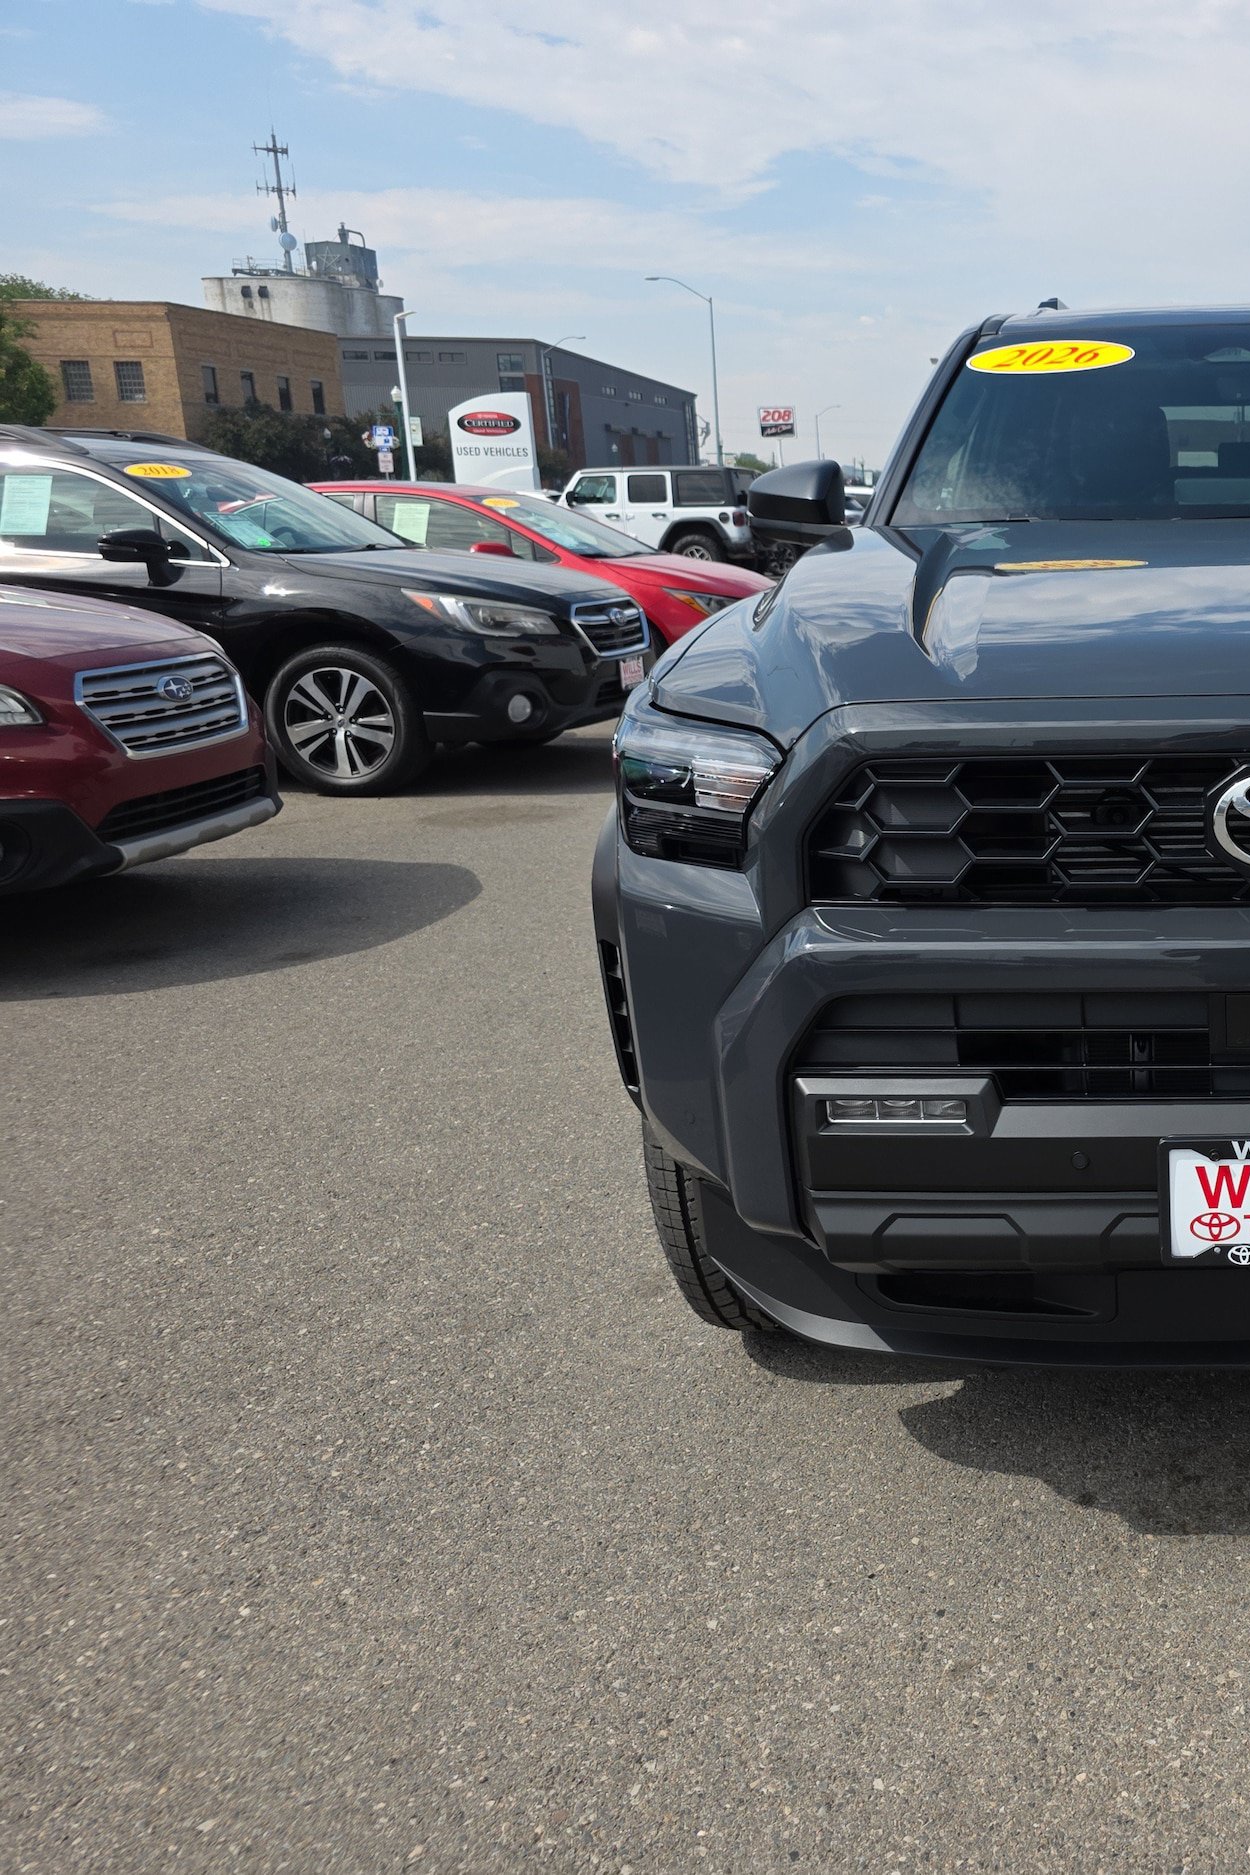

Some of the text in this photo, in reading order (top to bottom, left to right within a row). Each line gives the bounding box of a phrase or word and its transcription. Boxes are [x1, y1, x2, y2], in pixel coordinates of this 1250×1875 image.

[991, 345, 1109, 368] 2026
[762, 410, 792, 422] 208
[456, 447, 528, 457] USED VEHICLES
[138, 466, 180, 475] 2018
